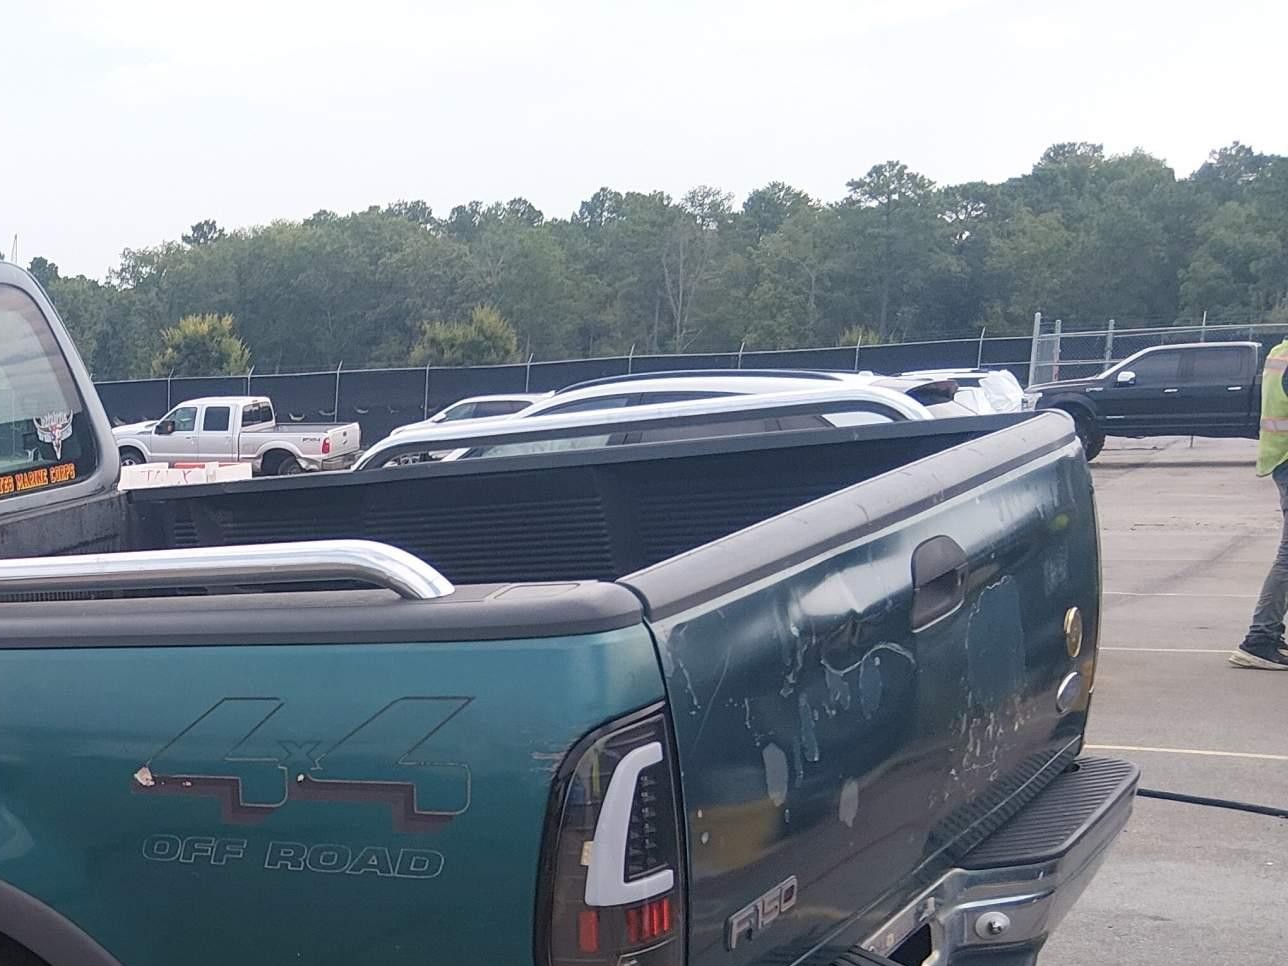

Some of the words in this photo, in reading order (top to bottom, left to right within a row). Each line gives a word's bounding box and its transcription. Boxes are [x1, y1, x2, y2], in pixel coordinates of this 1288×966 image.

[15, 468, 49, 491] MARINE
[49, 463, 76, 484] CORPS
[142, 834, 248, 866] OFF
[264, 841, 445, 880] ROAD
